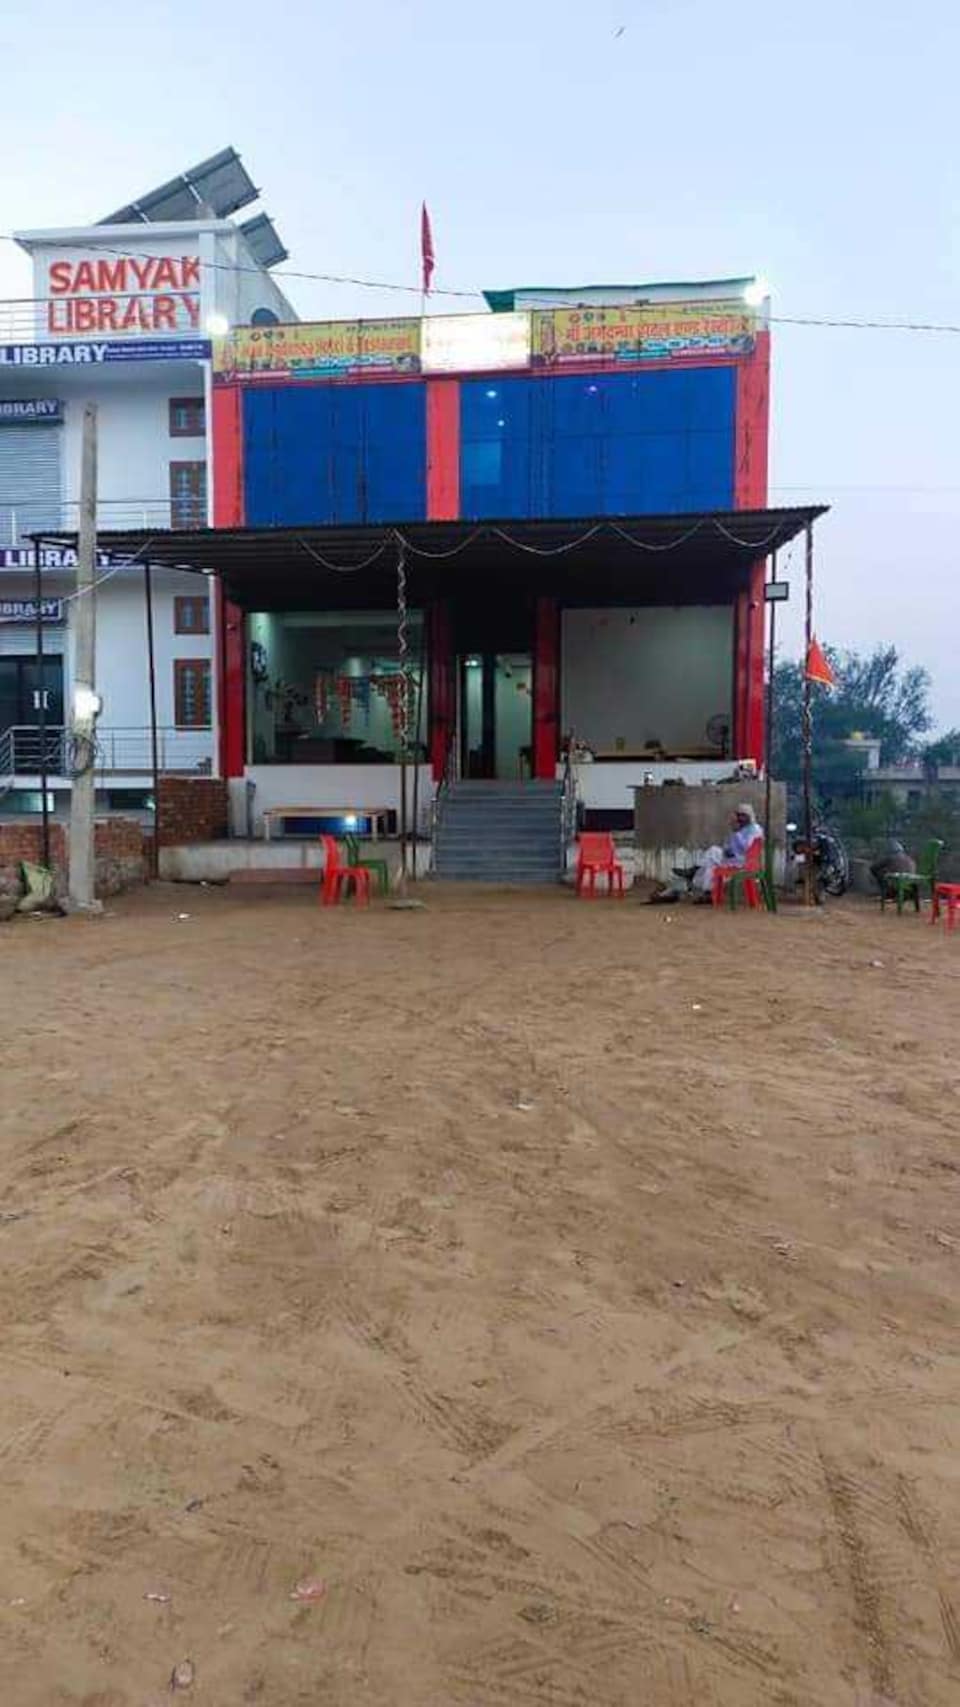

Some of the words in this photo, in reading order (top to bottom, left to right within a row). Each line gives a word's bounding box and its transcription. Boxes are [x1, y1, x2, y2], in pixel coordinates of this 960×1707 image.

[48, 255, 200, 294] SAMYAK
[48, 295, 200, 333] LIBRARY
[0, 344, 107, 364] LIBRARY
[0, 401, 57, 416] BRARY
[5, 549, 110, 567] LIBRAY
